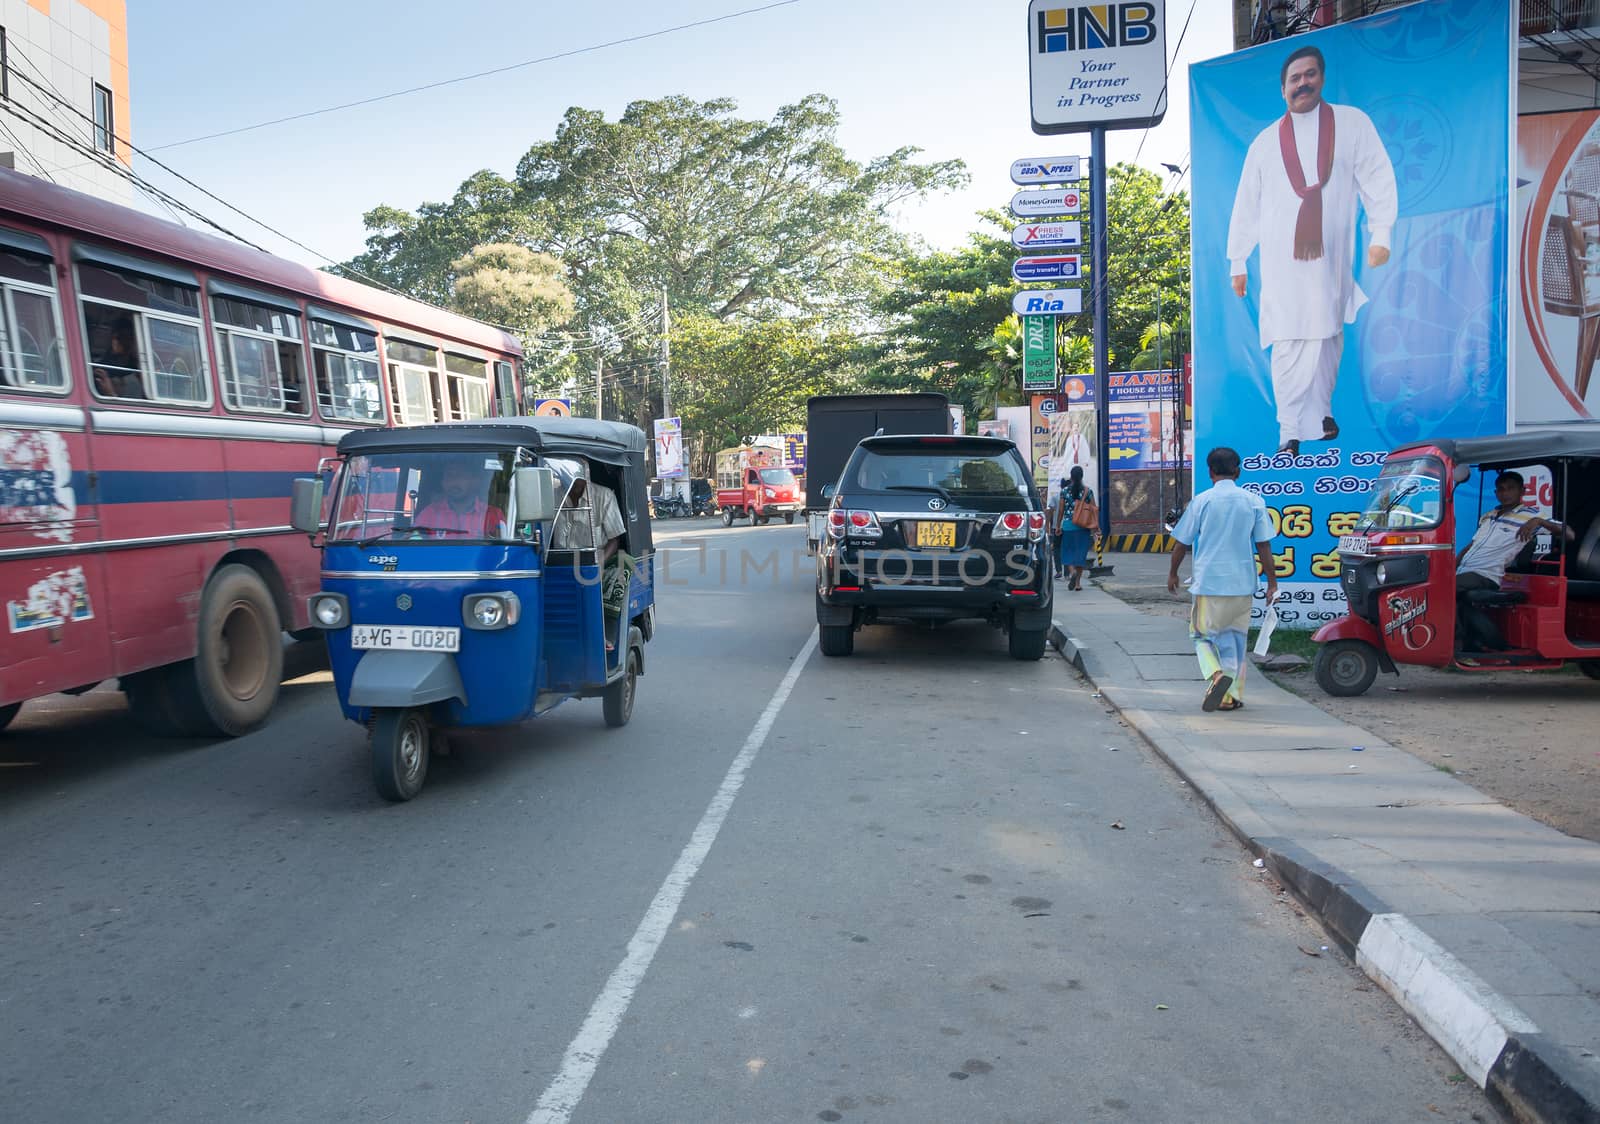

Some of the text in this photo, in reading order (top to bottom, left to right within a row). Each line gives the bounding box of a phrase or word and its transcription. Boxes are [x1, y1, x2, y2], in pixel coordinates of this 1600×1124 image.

[1038, 2, 1157, 53] HNB
[1080, 60, 1116, 73] Your
[1069, 77, 1129, 90] Partner
[1057, 92, 1142, 108] in Progress
[1026, 297, 1065, 312] Ria
[922, 534, 951, 546] 1713
[368, 555, 398, 565] ape
[412, 630, 456, 648] 0020
